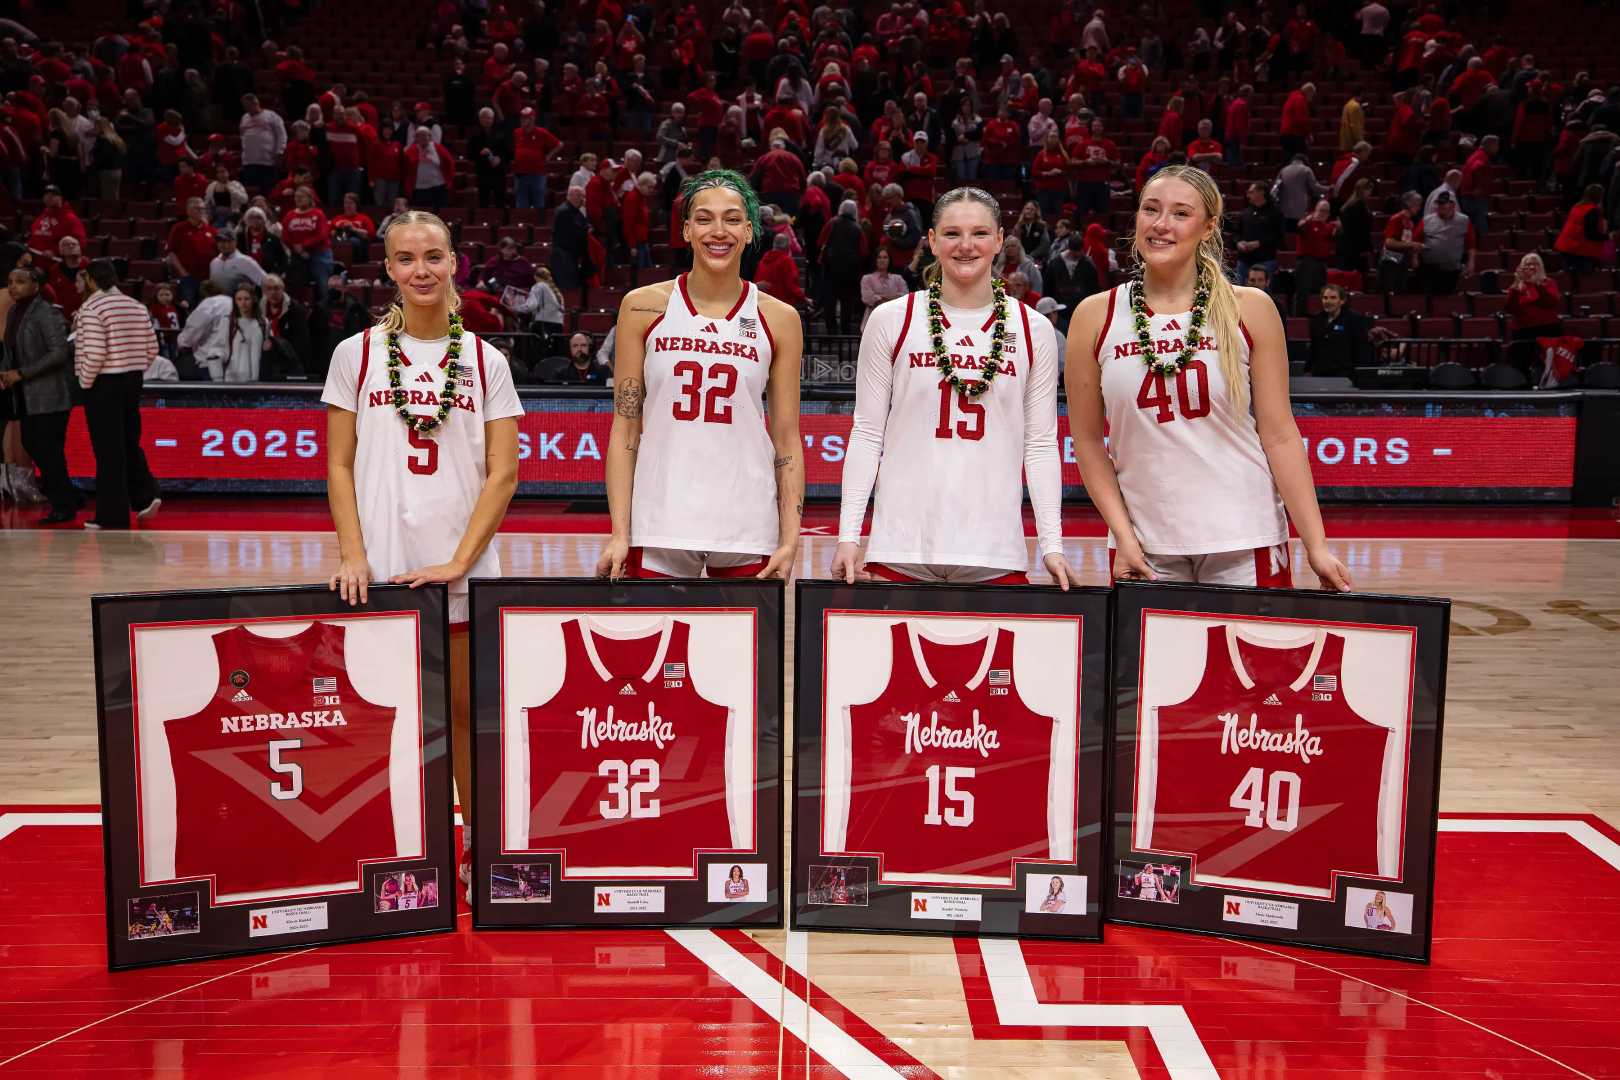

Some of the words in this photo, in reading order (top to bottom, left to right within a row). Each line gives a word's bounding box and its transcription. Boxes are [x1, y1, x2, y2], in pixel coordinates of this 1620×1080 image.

[654, 337, 760, 363] NEBRASKA
[672, 361, 739, 424] 32
[935, 377, 986, 442] 15
[1136, 359, 1211, 424] 40
[201, 430, 318, 458] 2025
[407, 414, 439, 476] 5
[220, 708, 348, 734] NEBRASKA
[576, 701, 676, 750] Nebraska
[900, 709, 1001, 758] Nebraska
[1217, 712, 1324, 764] Nebraska
[268, 738, 303, 801] 5
[598, 758, 661, 819] 32
[924, 765, 976, 828] 15
[1229, 766, 1301, 833] 40
[252, 914, 268, 929] N
[597, 893, 611, 906] N
[913, 898, 928, 912] N
[1226, 901, 1240, 915] N
